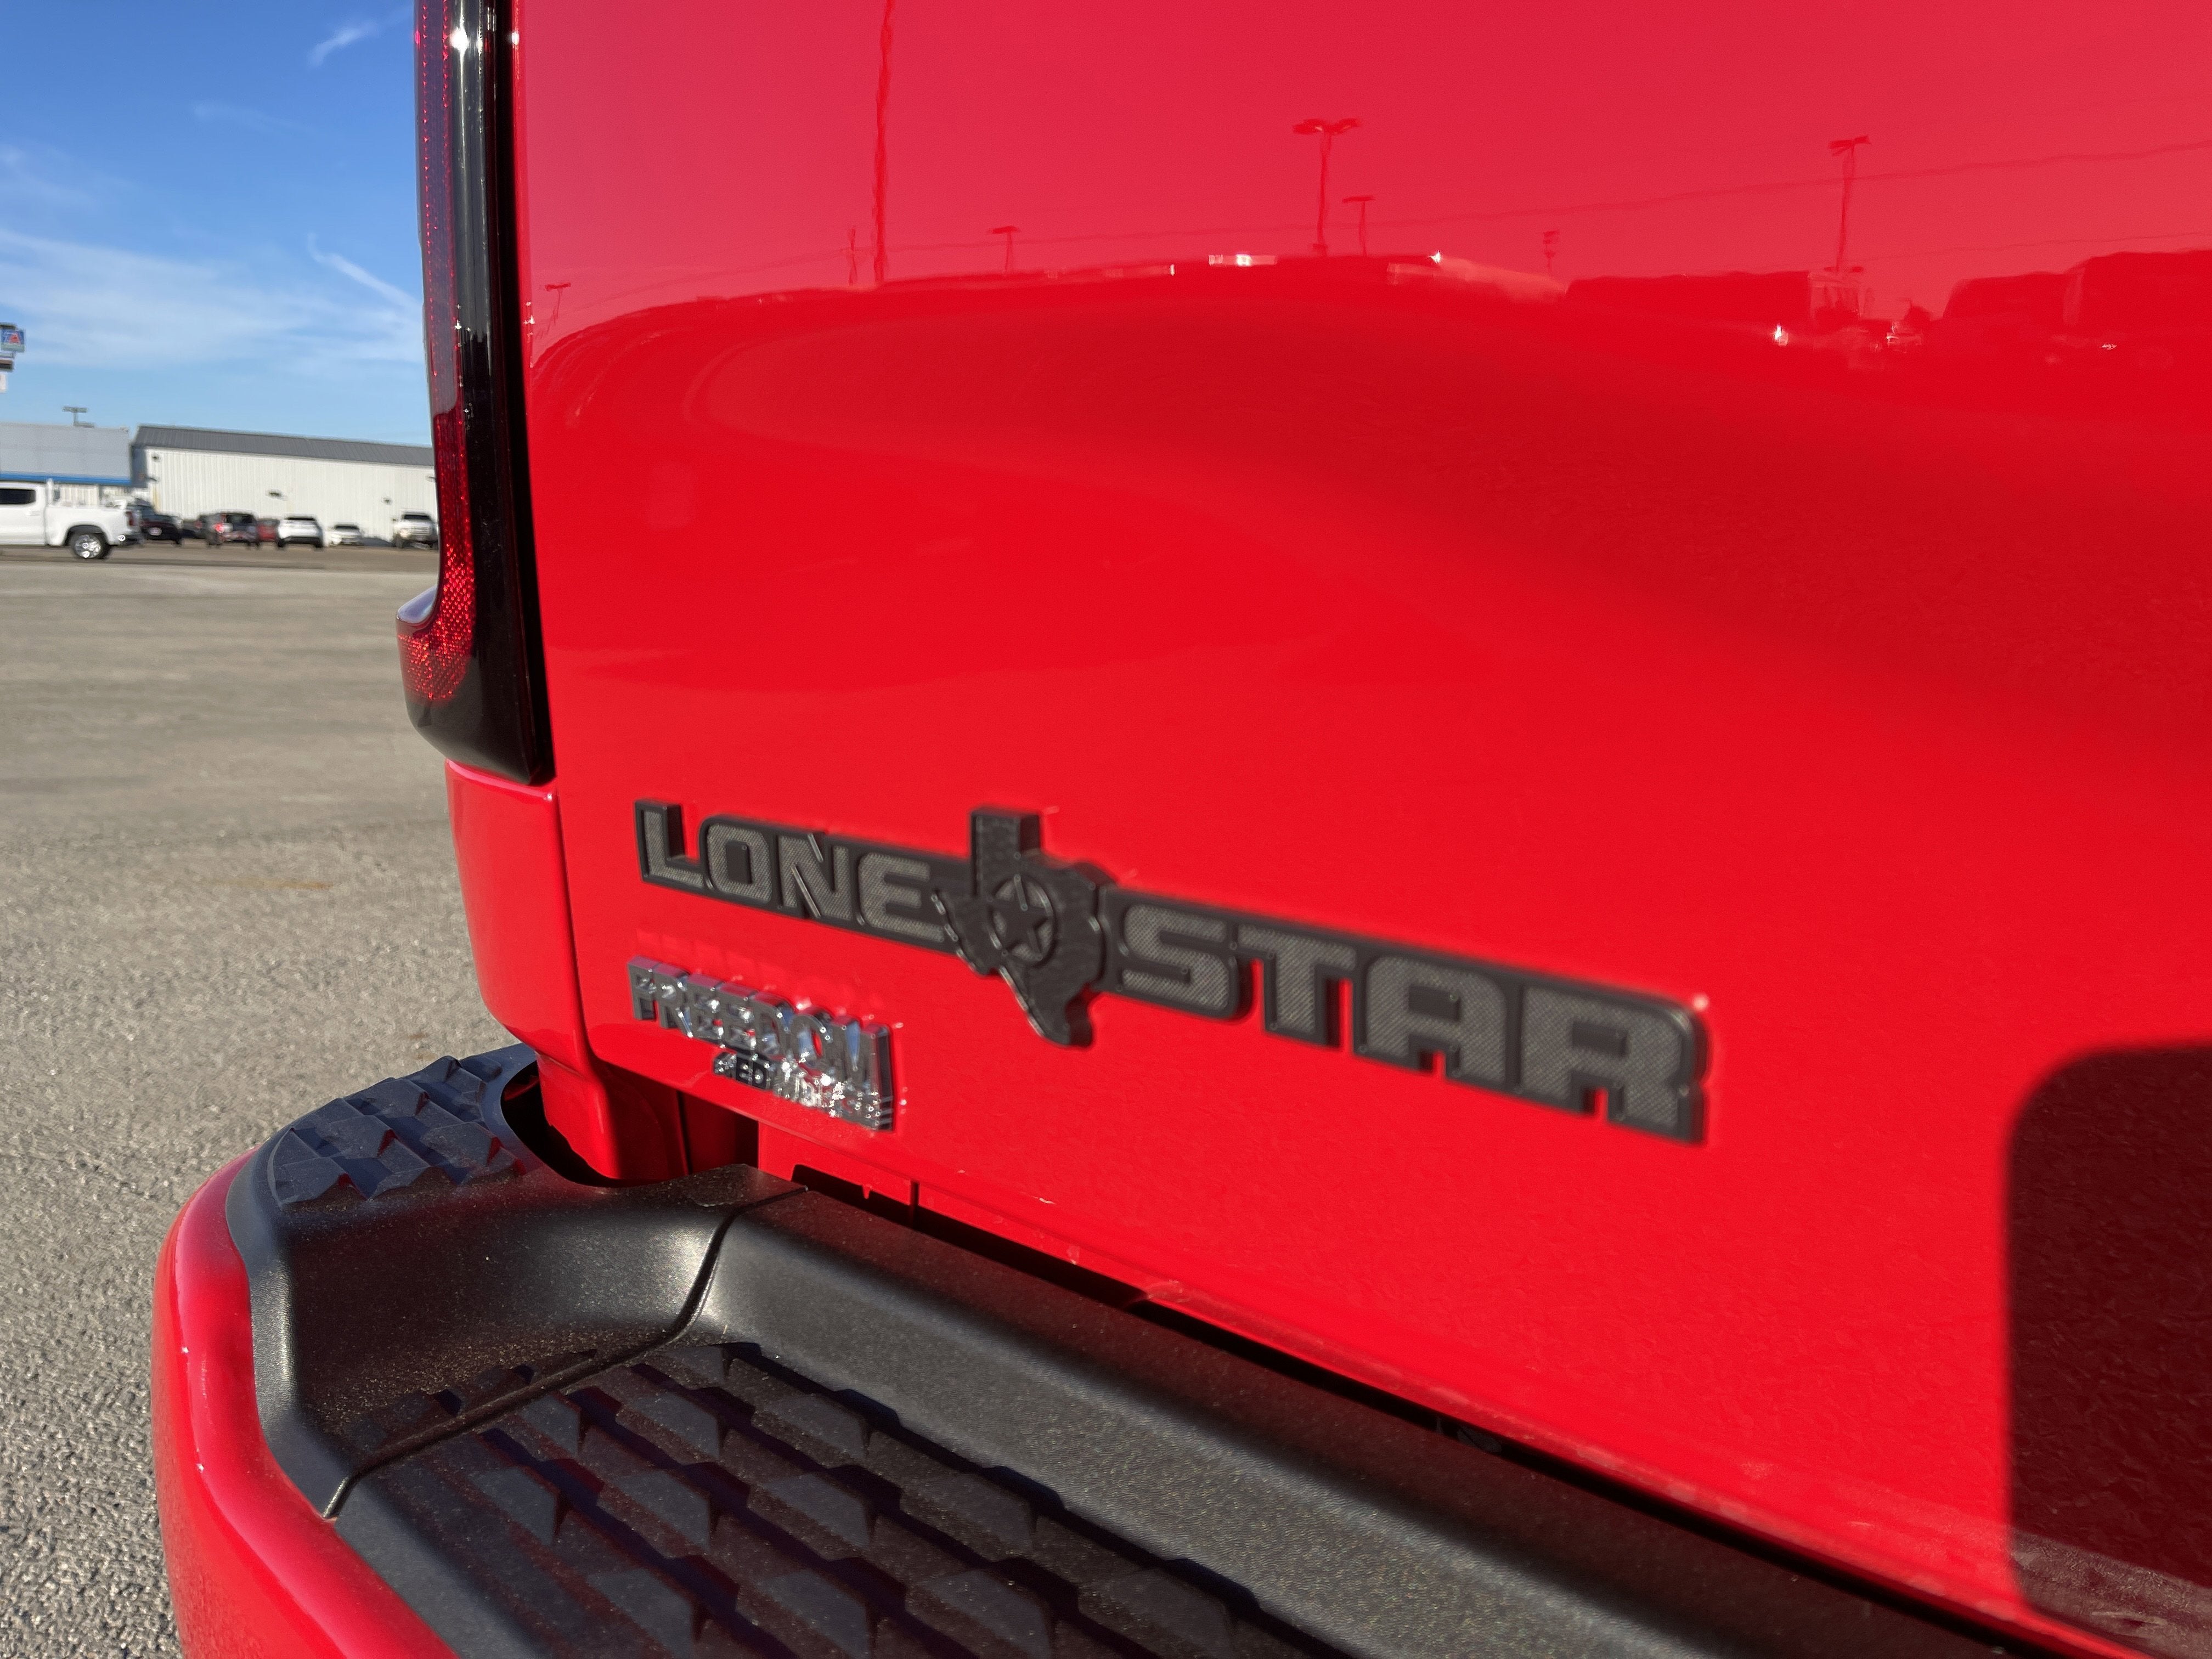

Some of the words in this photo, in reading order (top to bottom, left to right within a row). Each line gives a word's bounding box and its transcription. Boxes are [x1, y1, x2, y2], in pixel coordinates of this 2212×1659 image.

[628, 956, 893, 1097] FREEDOM
[635, 800, 952, 949] LONE
[1114, 889, 1707, 1146] STAR
